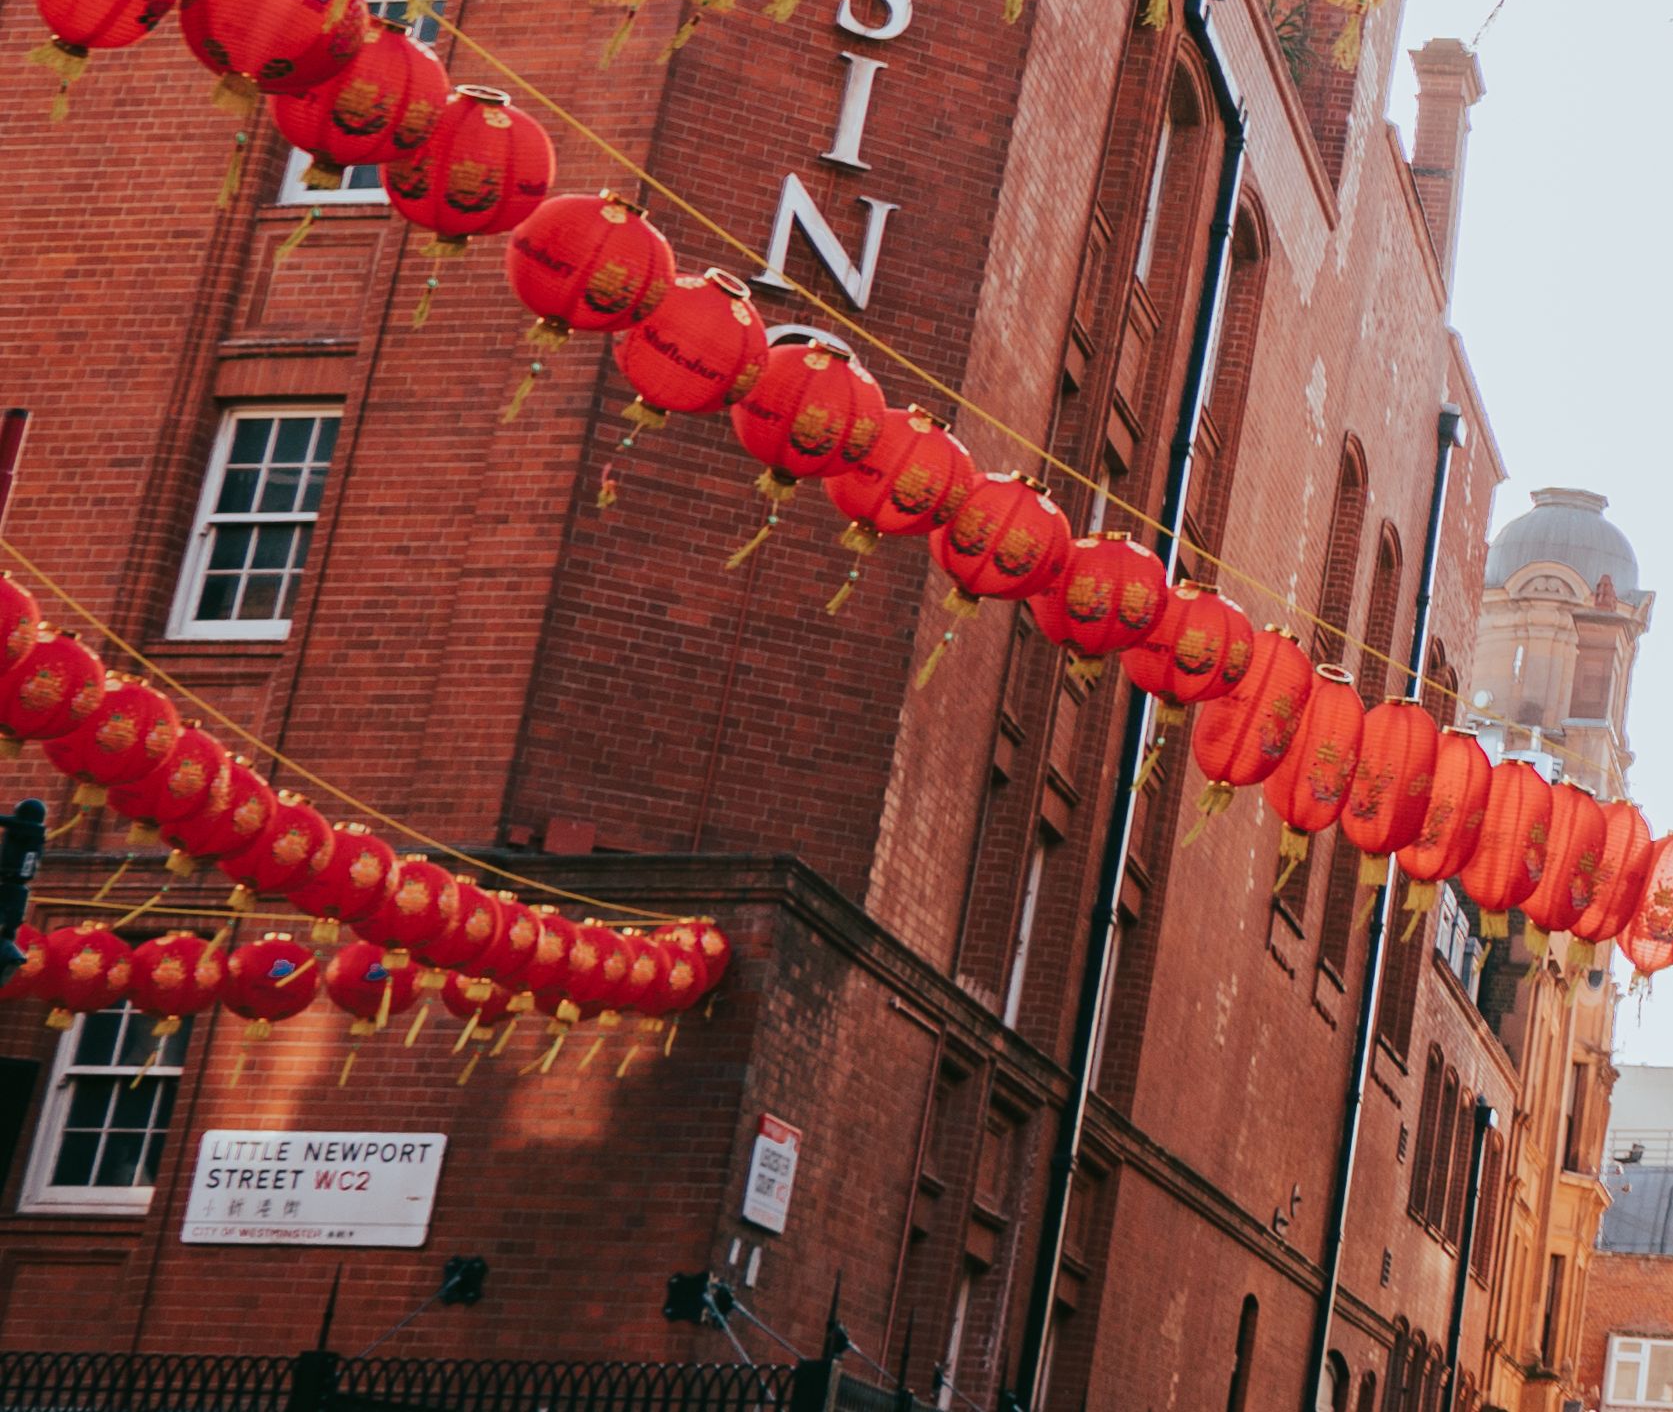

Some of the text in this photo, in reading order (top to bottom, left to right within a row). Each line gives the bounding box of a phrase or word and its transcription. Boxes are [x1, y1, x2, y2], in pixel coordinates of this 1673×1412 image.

[211, 1141, 432, 1164] LITTLE NEWPORT
[206, 1169, 371, 1191] STREET WC2
